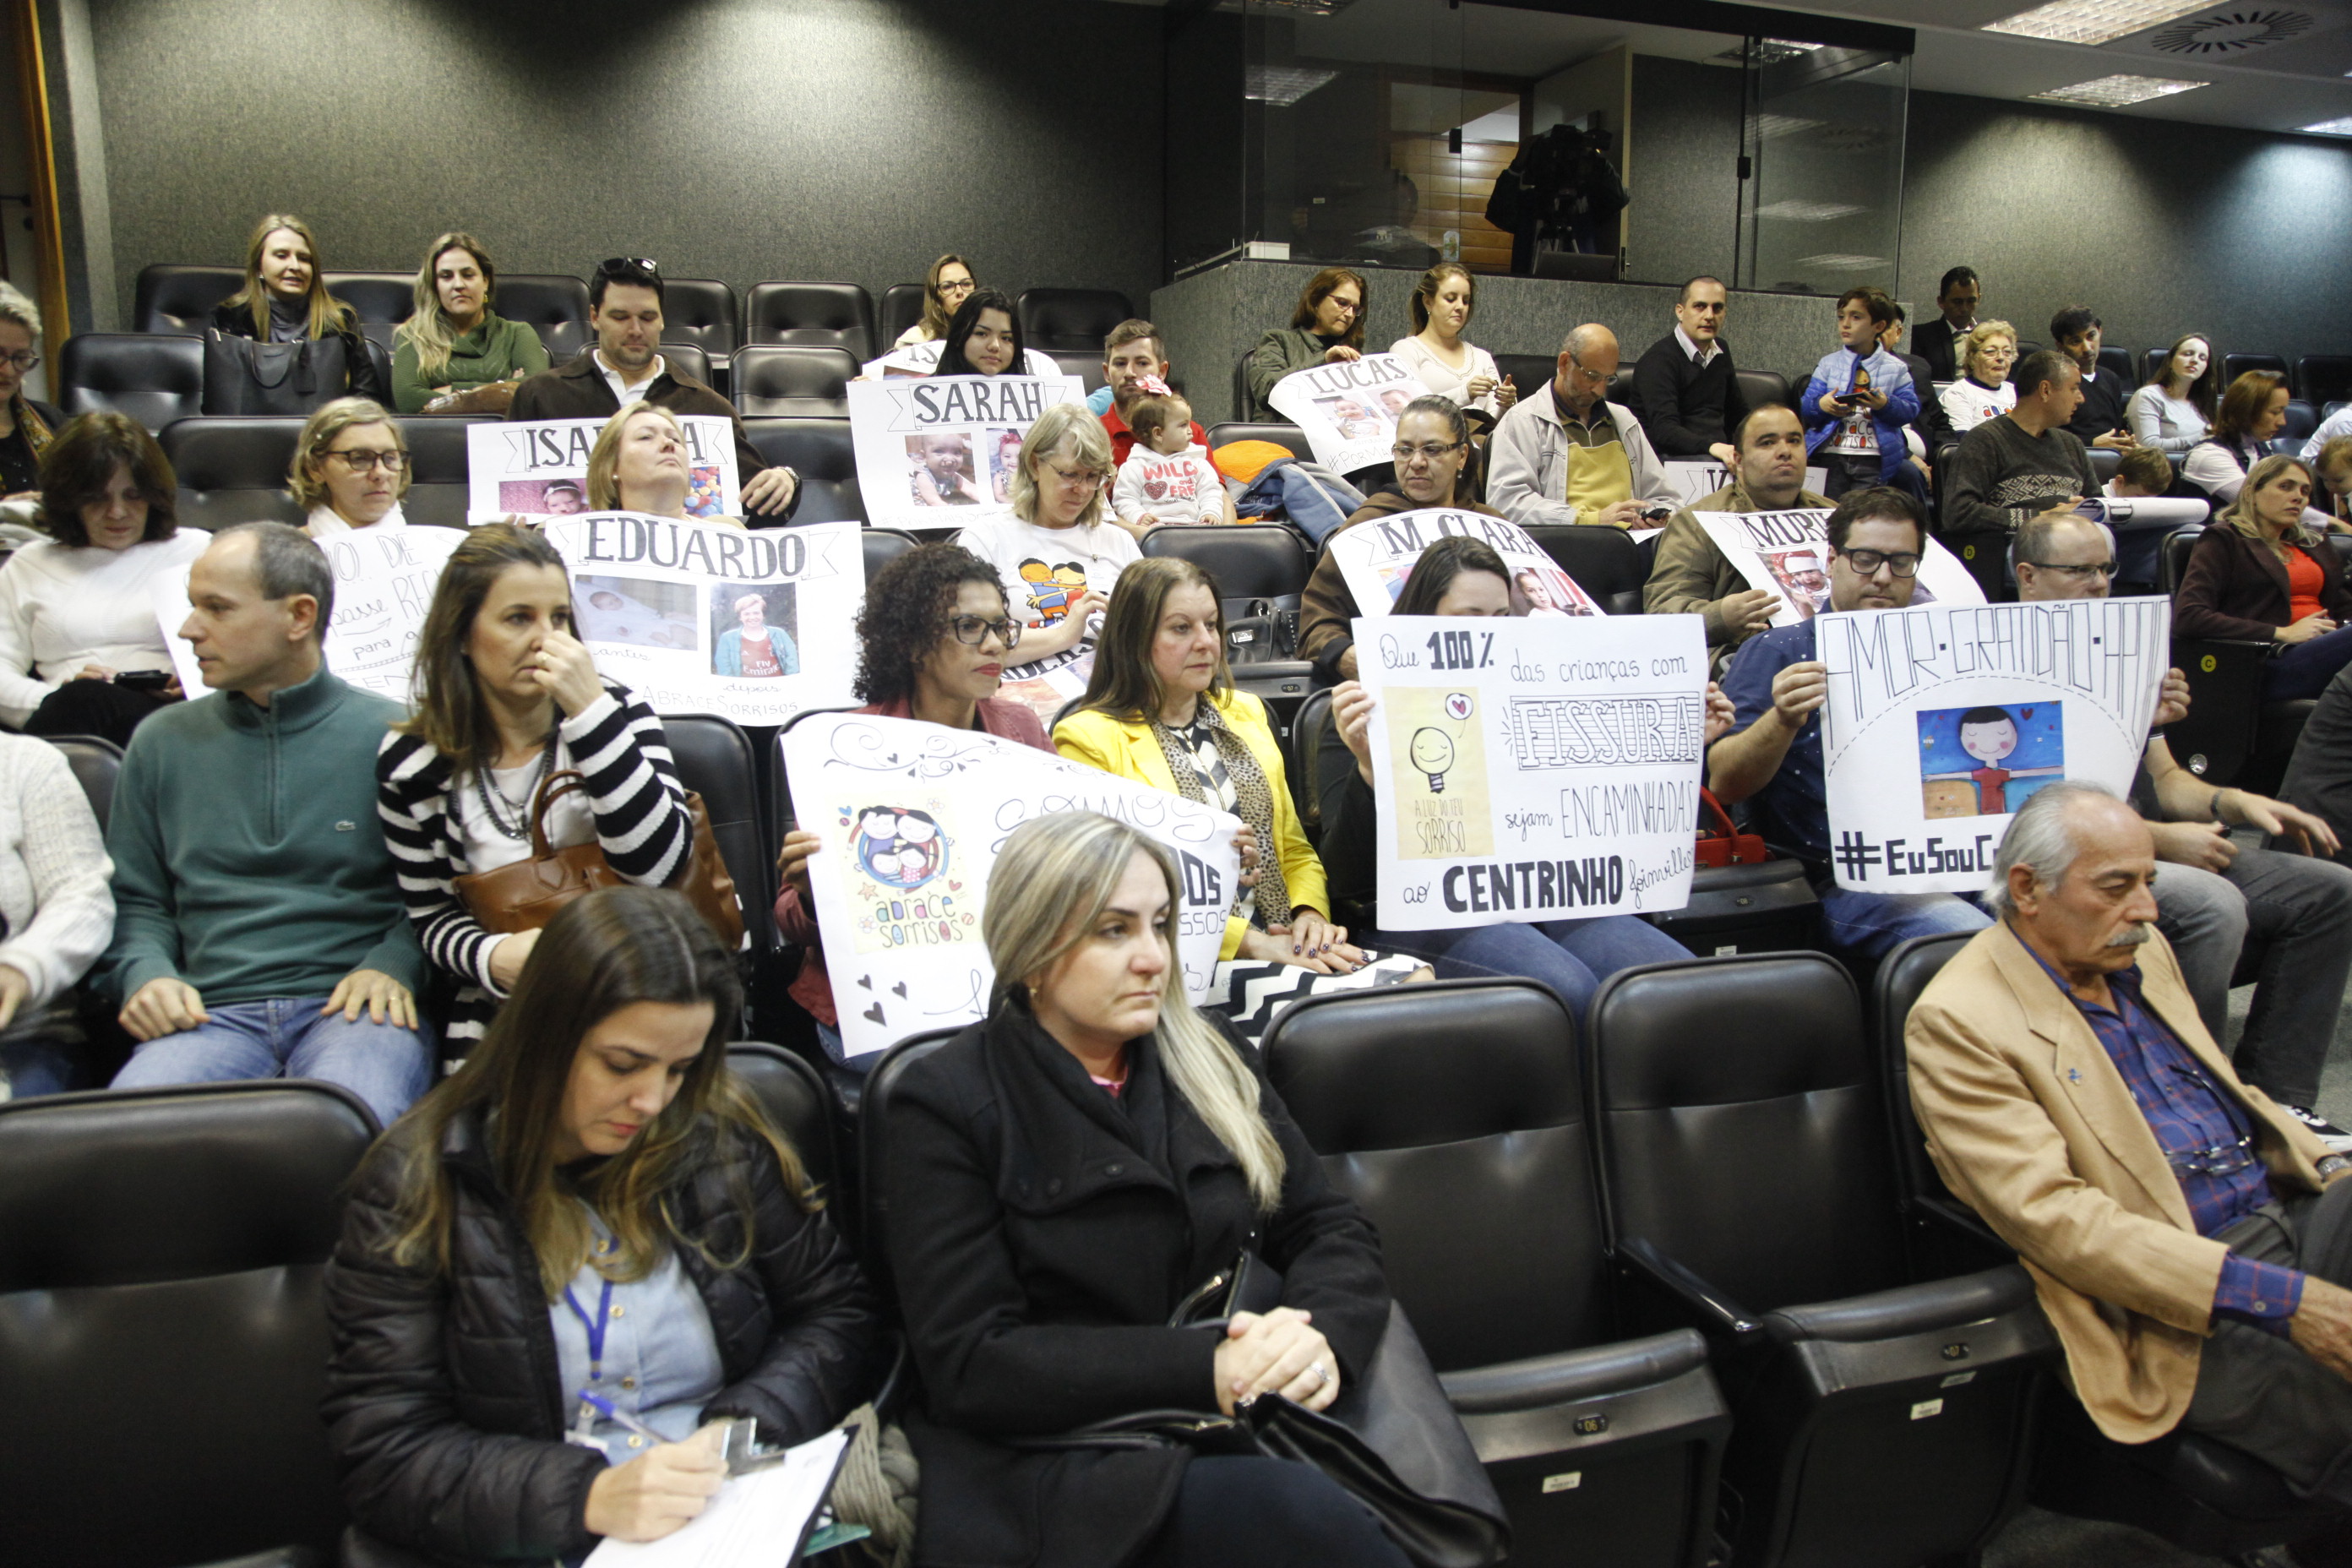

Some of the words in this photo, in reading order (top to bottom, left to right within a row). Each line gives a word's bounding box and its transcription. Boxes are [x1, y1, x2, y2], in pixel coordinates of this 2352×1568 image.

[1305, 358, 1407, 394] LUCAS
[913, 381, 1042, 422] SARAH
[526, 422, 705, 467] ISAA
[1837, 419, 1873, 435] brace
[1169, 484, 1195, 498] FRE
[1179, 477, 1192, 486] and
[1740, 512, 1829, 547] MURI
[376, 533, 422, 568] DE
[584, 516, 806, 580] EDUARDO
[352, 639, 391, 661] para
[1380, 634, 1419, 669] Que
[1511, 648, 1545, 682] das
[1560, 658, 1640, 683] crianças
[1652, 656, 1688, 677] com
[723, 683, 781, 694] depois
[1822, 611, 1941, 750] AMOR
[1950, 602, 2093, 692] GRATIDÃO
[625, 683, 798, 716] ABRACESORRISOS
[1516, 697, 1696, 768] FISSURA
[1505, 808, 1553, 841] sejam
[1561, 781, 1693, 839] ENCAMINHADAS
[1416, 818, 1466, 854] SORRISO
[1835, 830, 1995, 881] #EuSouC
[1403, 881, 1430, 905] ao
[1442, 855, 1623, 913] CENTRINHO
[879, 919, 962, 948] sorrisos
[1179, 910, 1227, 935] SSOS
